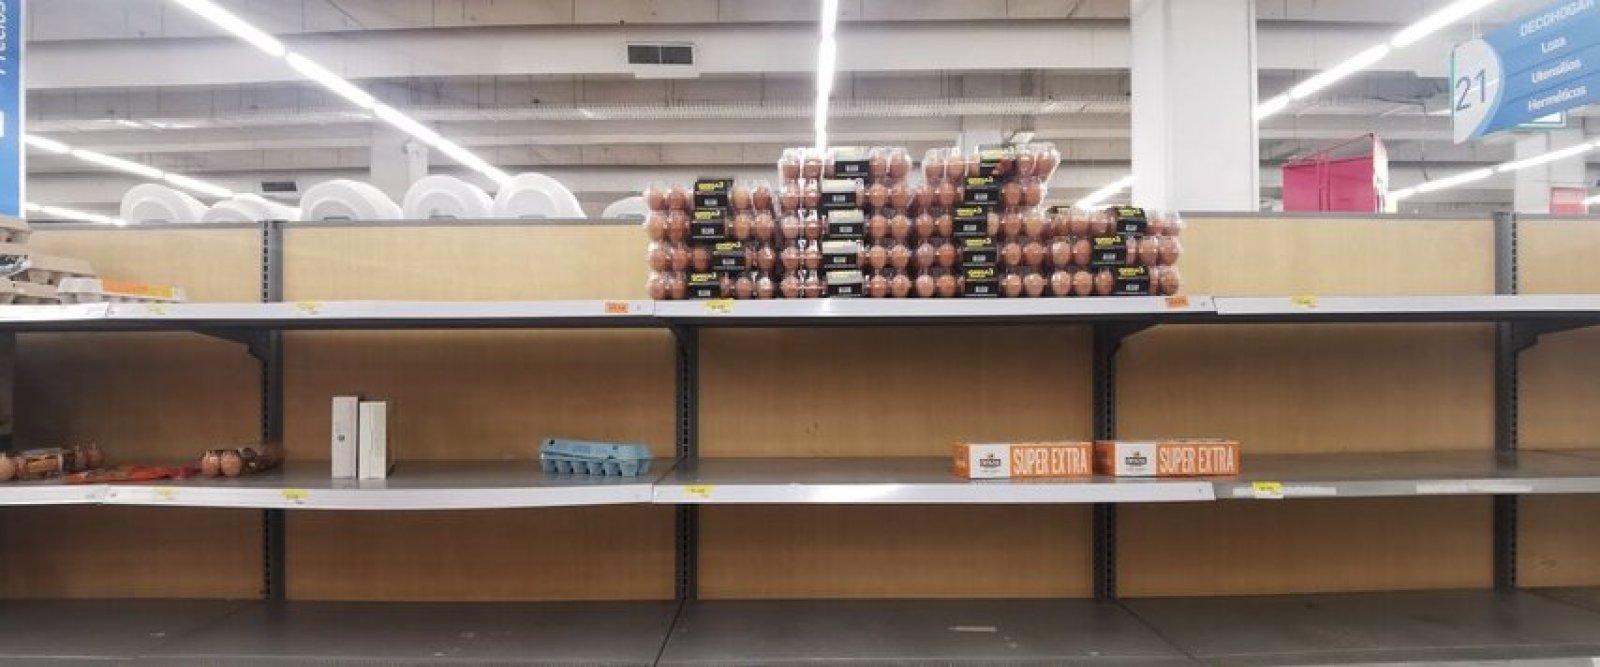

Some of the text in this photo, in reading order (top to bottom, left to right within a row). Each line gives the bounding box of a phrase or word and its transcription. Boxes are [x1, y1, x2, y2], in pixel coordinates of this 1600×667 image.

[1455, 68, 1486, 111] 21
[1013, 447, 1088, 475] SUPER EXTRA
[1160, 446, 1235, 473] SUPER EXTRA
